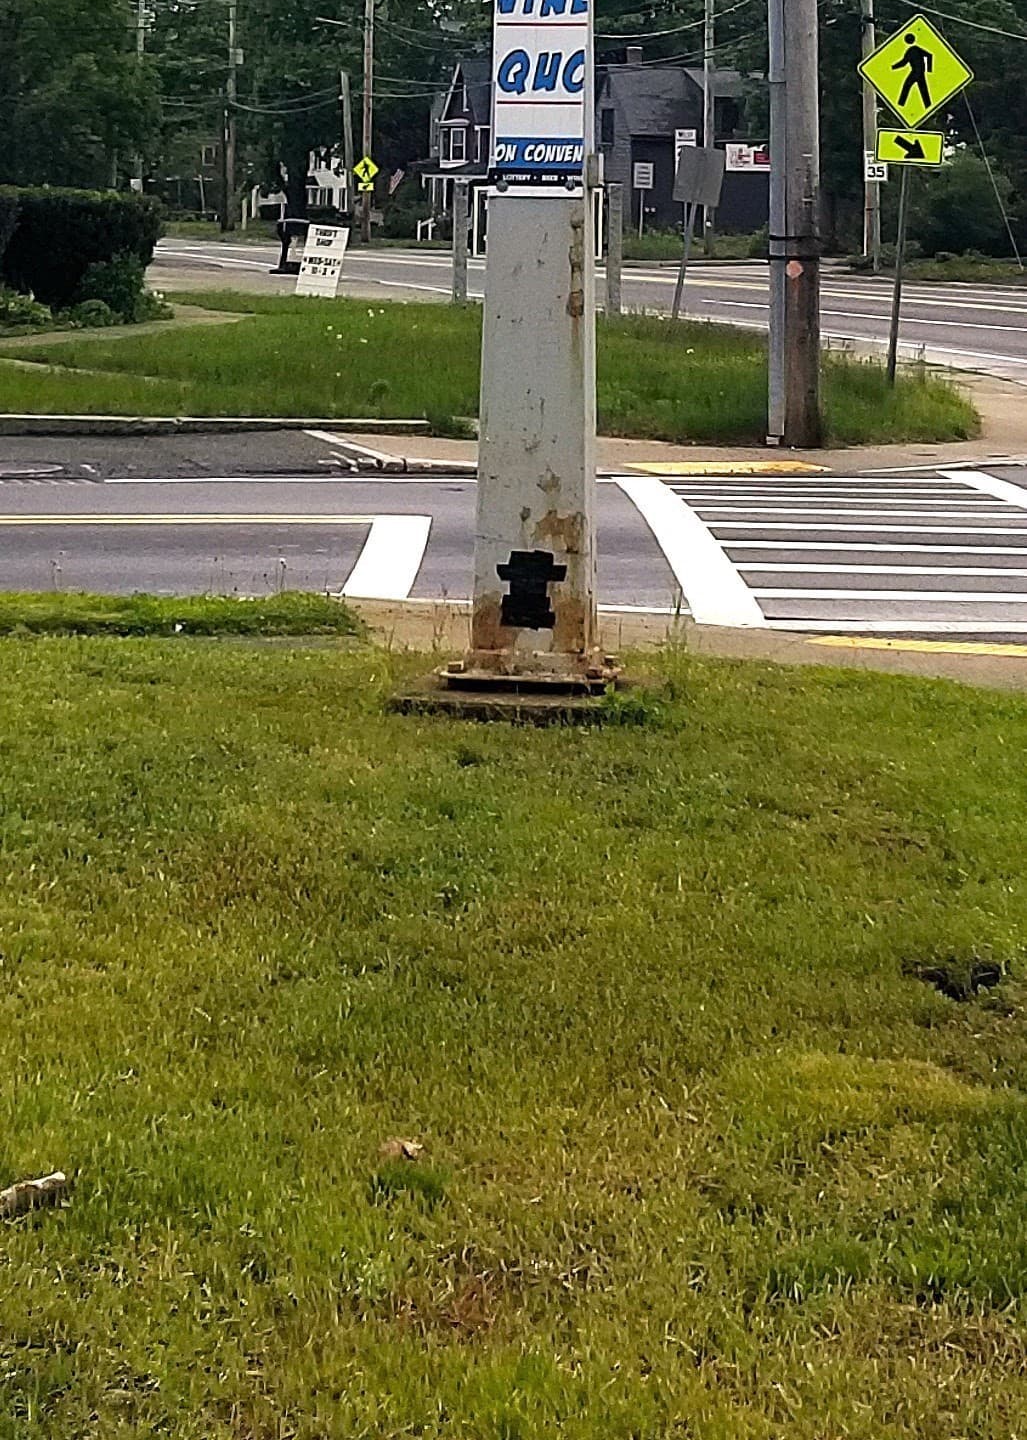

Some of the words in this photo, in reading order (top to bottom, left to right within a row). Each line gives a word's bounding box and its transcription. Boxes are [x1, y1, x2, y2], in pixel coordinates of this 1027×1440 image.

[496, 143, 517, 162] ON
[524, 143, 583, 163] CONVEN
[867, 166, 885, 178] 35
